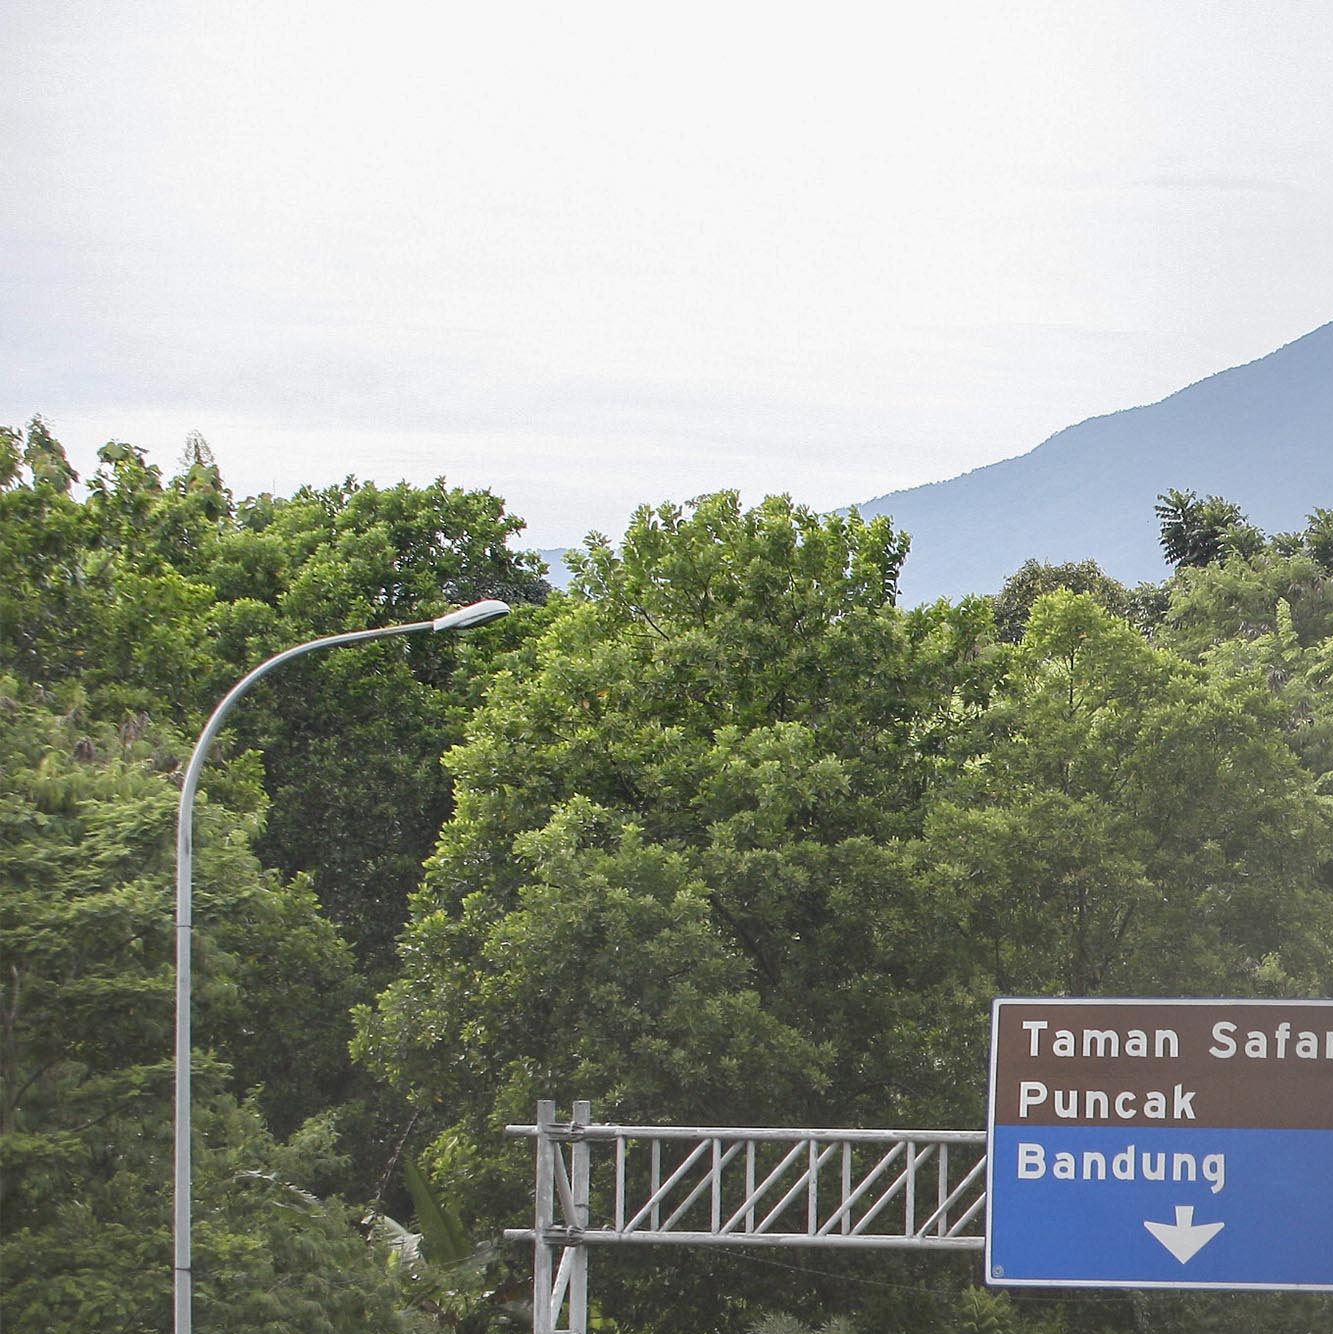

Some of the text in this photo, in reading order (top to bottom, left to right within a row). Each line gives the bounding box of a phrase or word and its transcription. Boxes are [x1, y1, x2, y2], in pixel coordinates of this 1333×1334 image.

[1022, 1020, 1180, 1058] Taman
[1018, 1081, 1197, 1120] Puncak
[1017, 1143, 1225, 1194] Bandung
